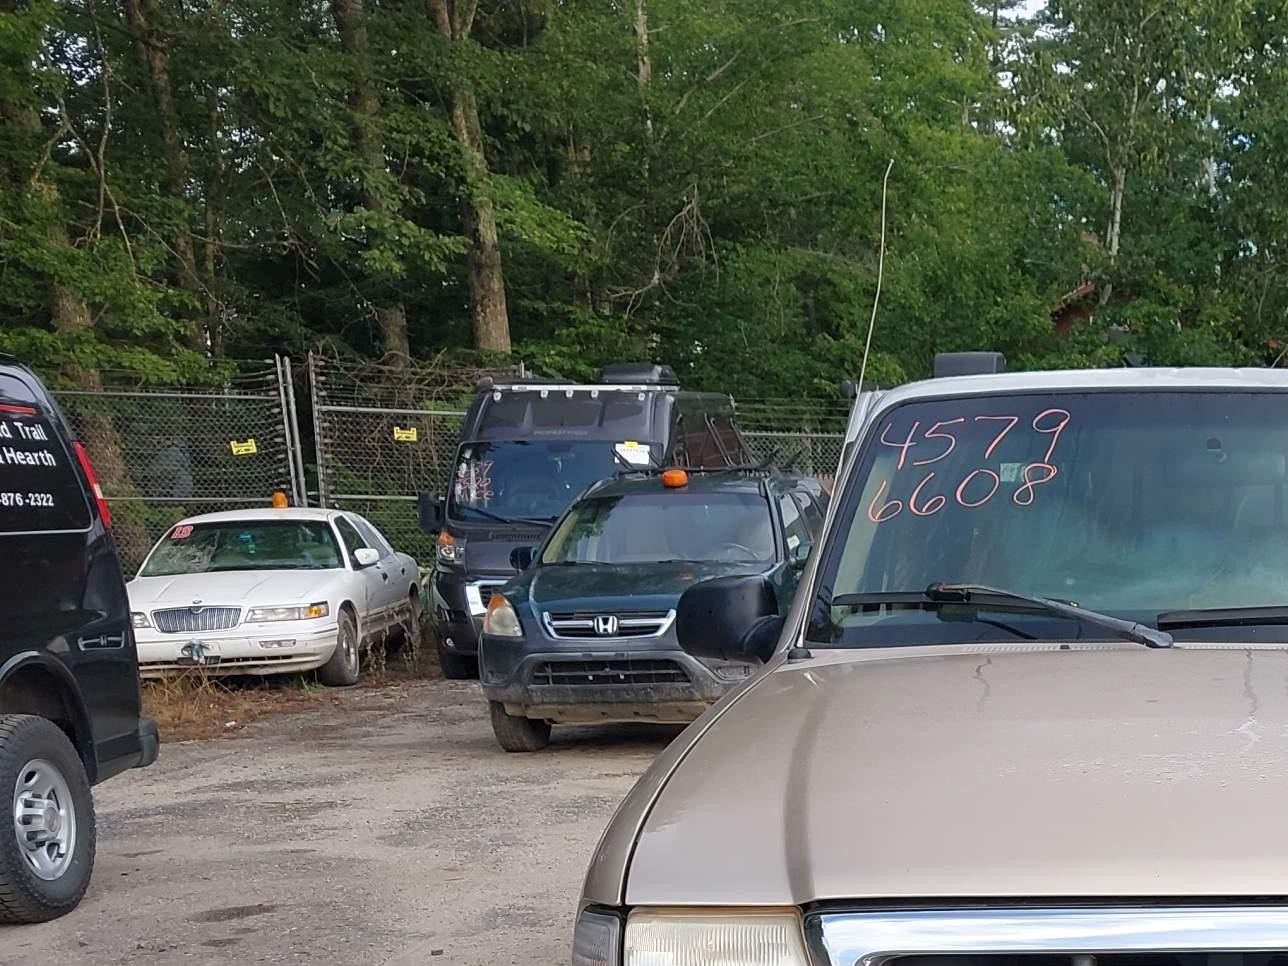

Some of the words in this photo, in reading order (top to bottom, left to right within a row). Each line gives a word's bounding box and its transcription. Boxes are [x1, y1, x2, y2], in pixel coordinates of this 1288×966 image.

[13, 421, 49, 441] Trail
[880, 409, 1071, 471] 4579
[2, 447, 57, 467] Hearth
[868, 462, 1057, 523] 6608
